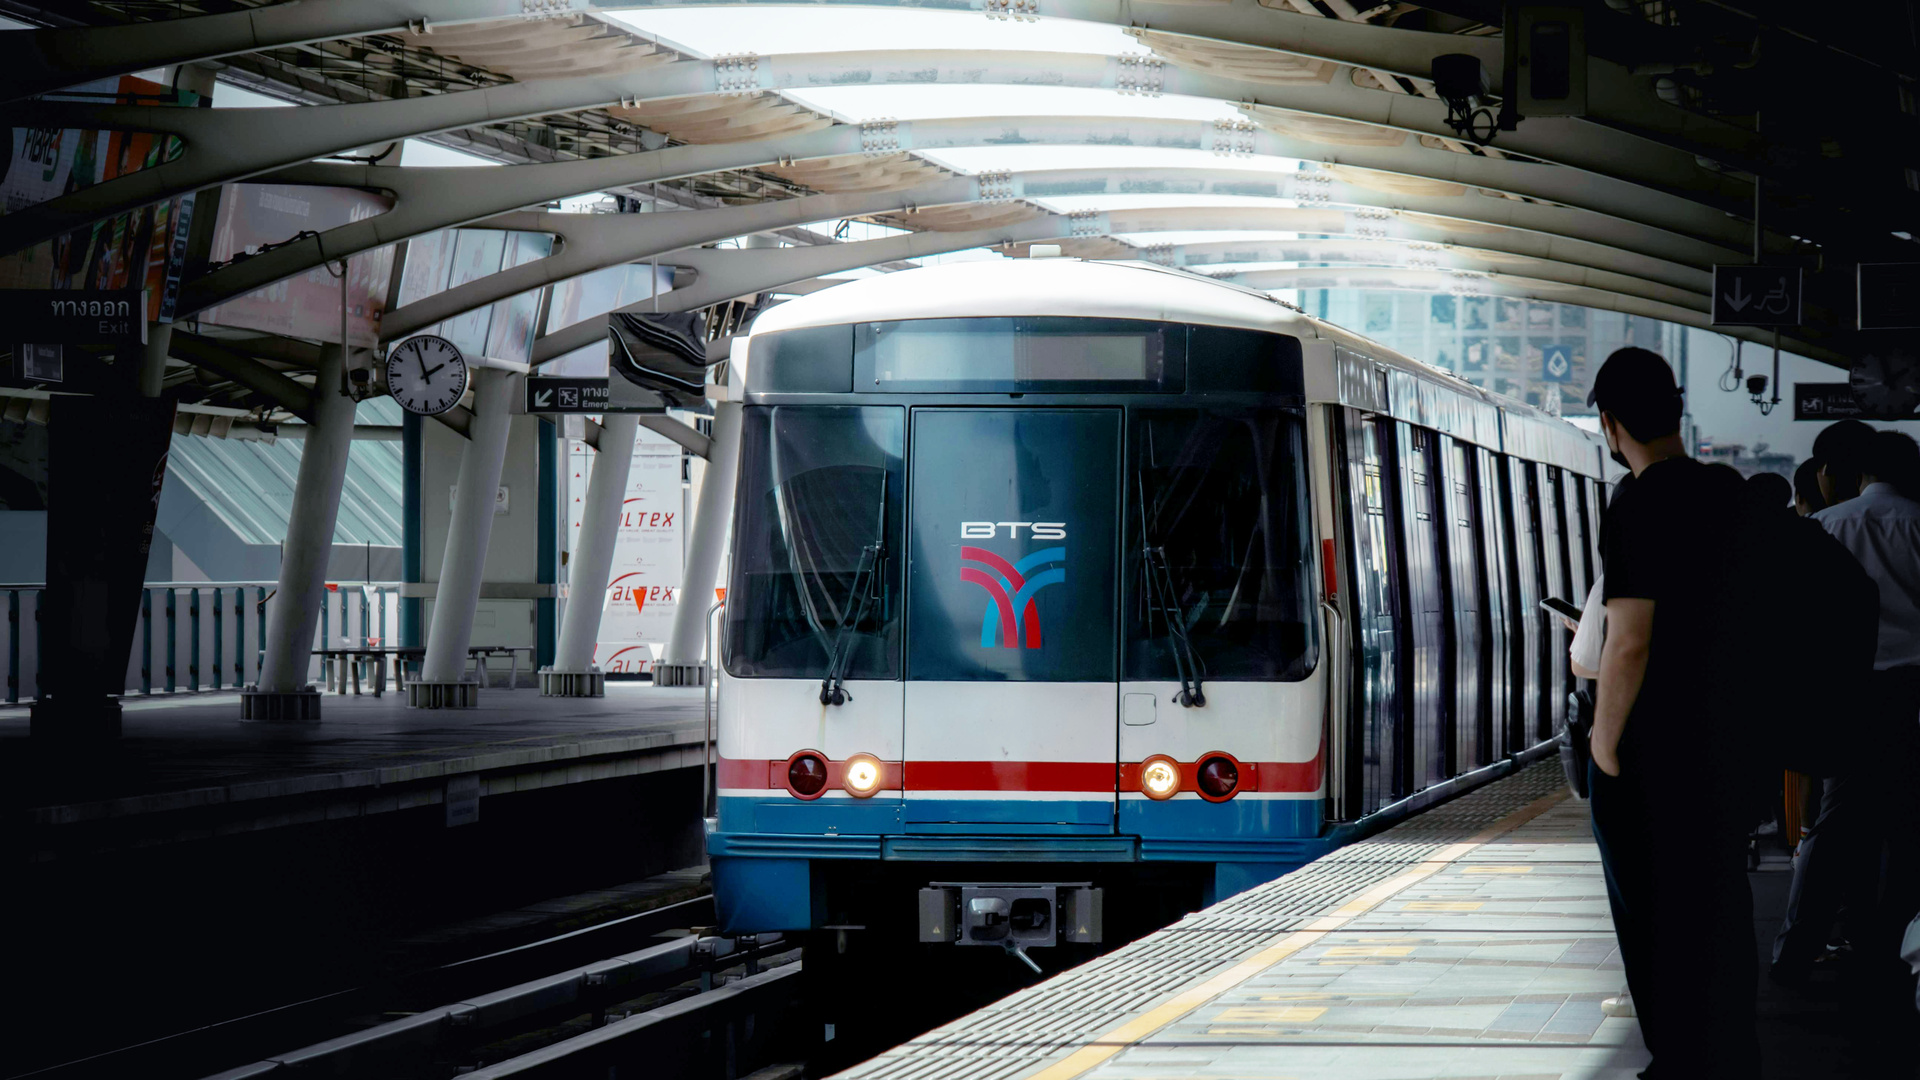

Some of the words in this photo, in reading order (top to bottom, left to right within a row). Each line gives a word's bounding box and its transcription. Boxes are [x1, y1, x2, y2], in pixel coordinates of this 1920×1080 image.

[51, 300, 130, 317] ทางออก
[98, 320, 130, 334] Exit
[582, 386, 609, 398] ทางอ
[582, 400, 609, 410] Emerg
[960, 521, 1067, 540] BTS
